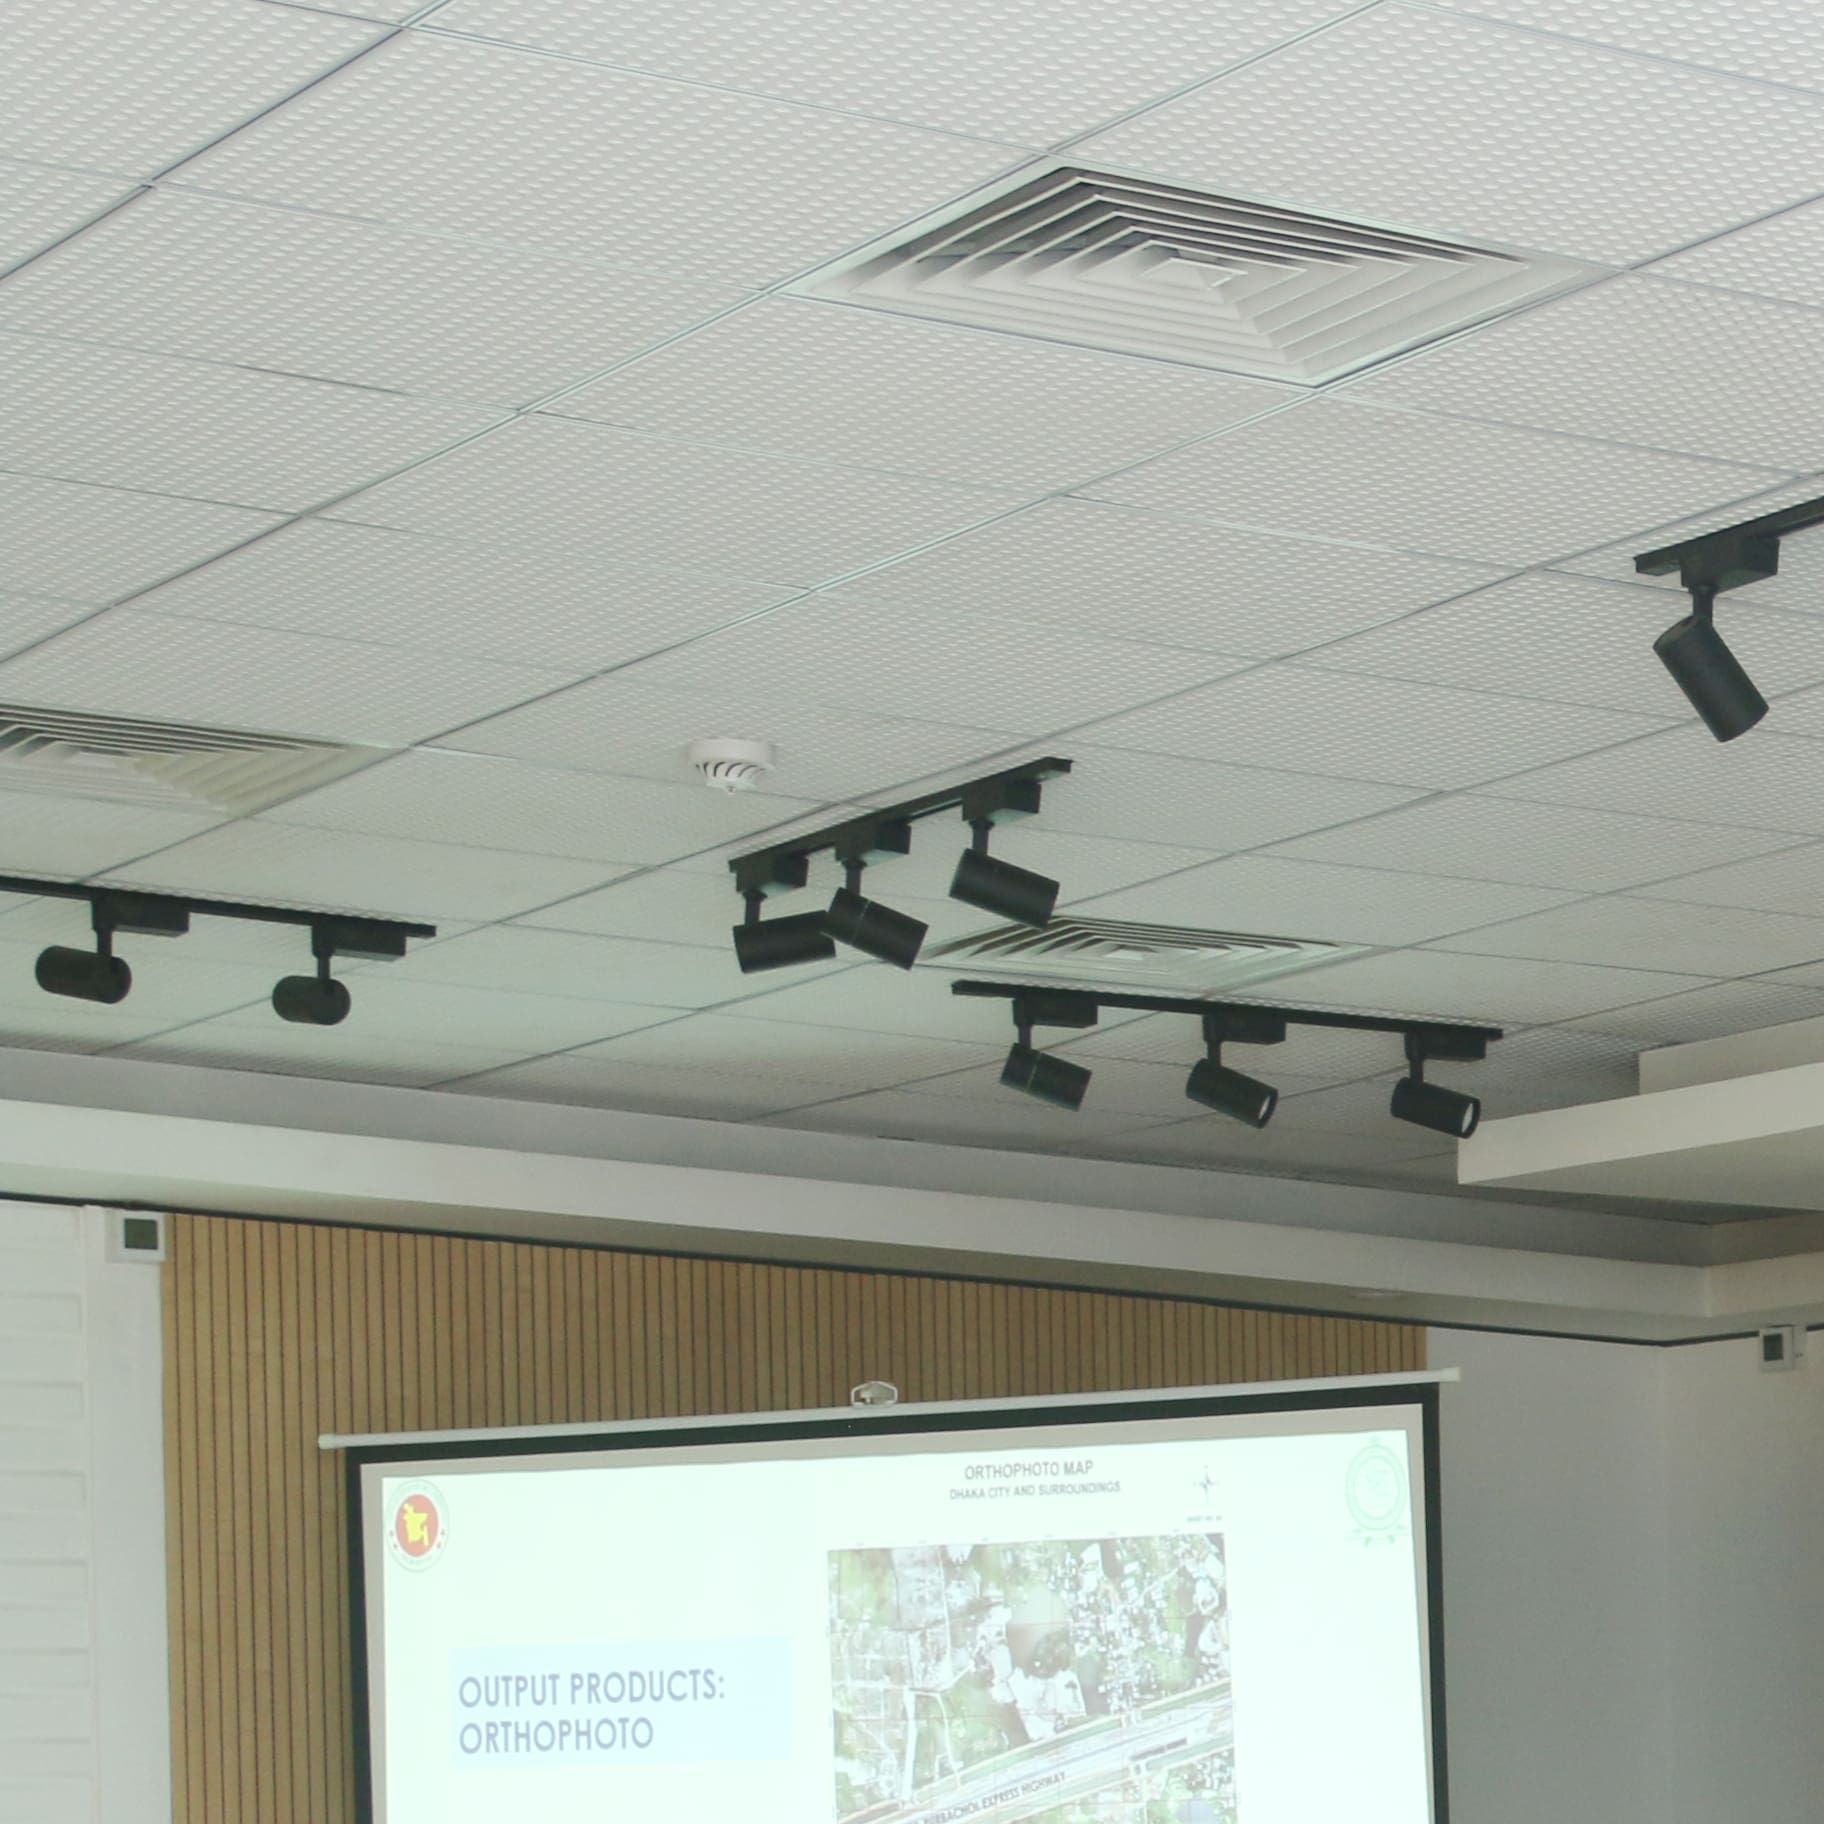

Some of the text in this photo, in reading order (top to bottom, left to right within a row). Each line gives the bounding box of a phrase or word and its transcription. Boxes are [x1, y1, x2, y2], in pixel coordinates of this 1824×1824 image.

[964, 1459, 1095, 1481] ORTHOPHOTO MAP
[988, 1485, 1012, 1500] CITY
[1013, 1484, 1037, 1497] AND
[459, 1669, 726, 1708] OUTPUT PRODUCTS:
[459, 1717, 654, 1755] ORTHOPHOTO
